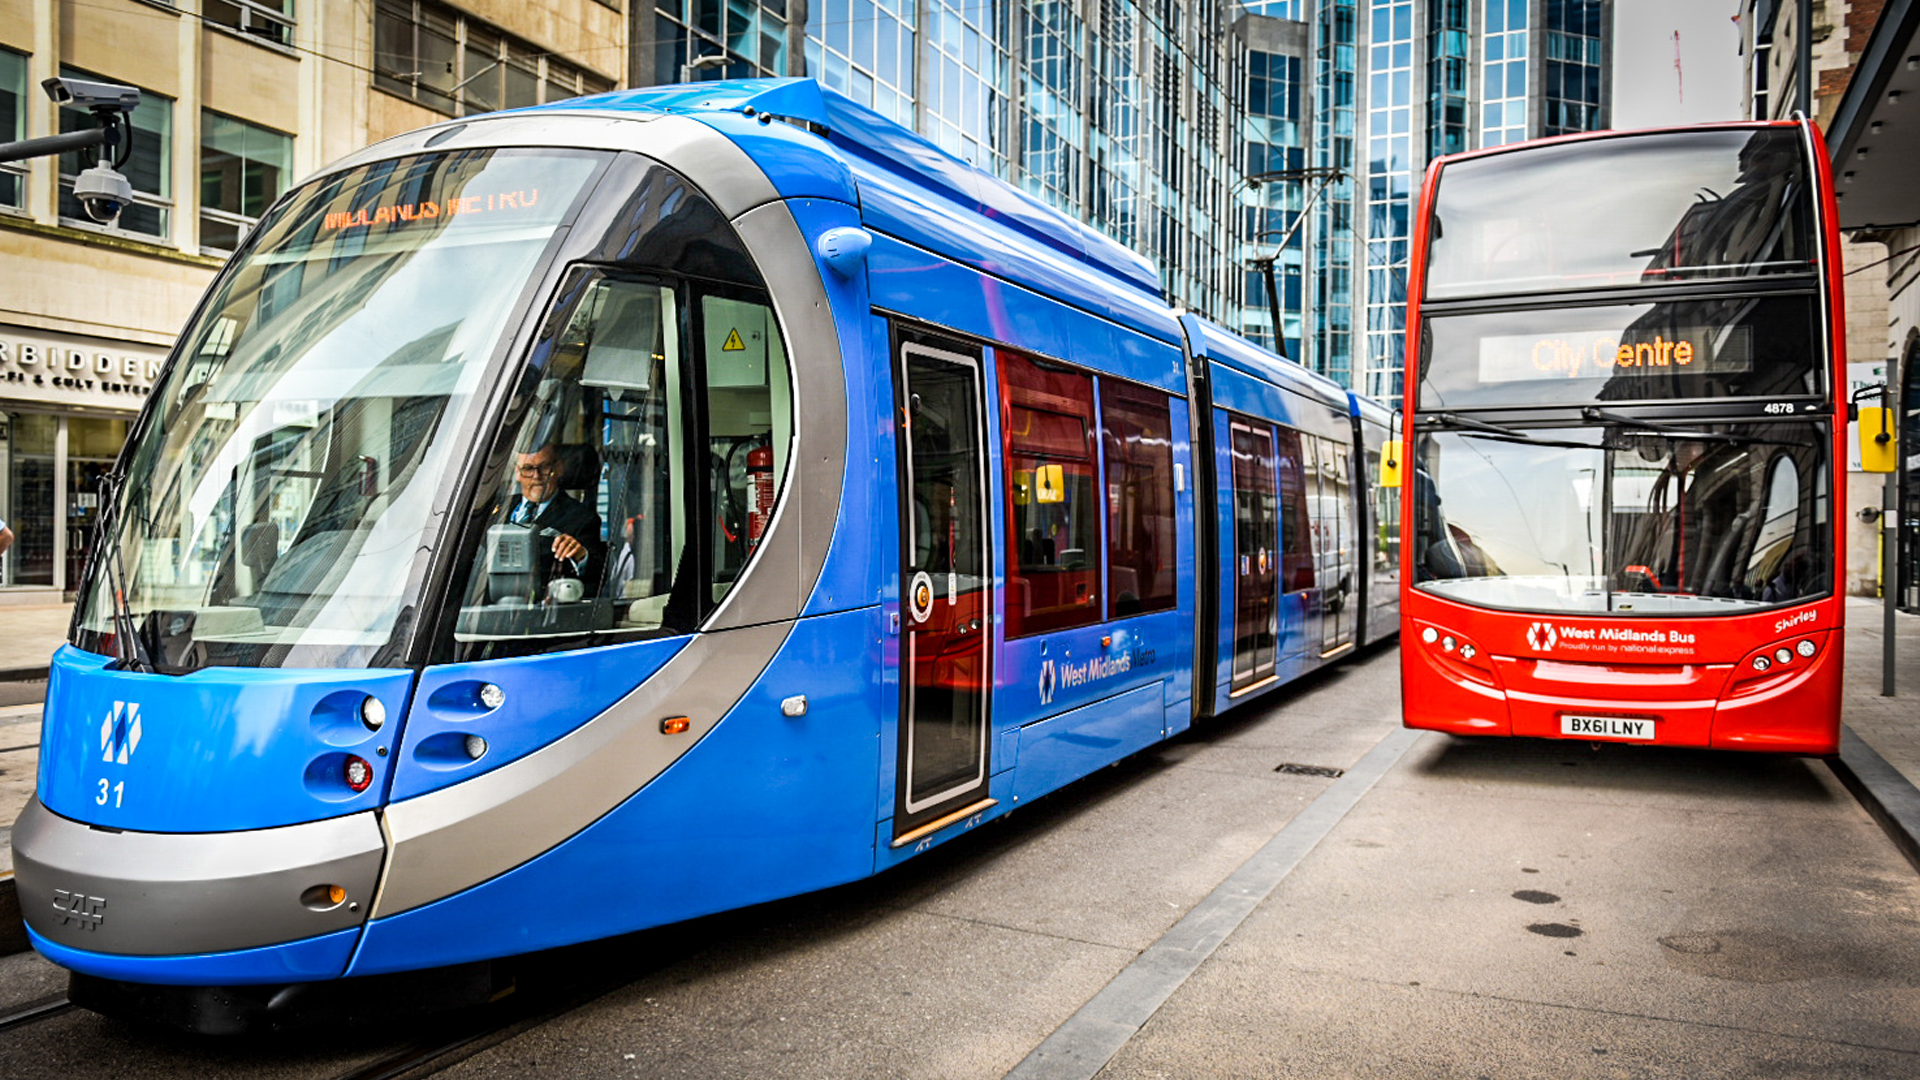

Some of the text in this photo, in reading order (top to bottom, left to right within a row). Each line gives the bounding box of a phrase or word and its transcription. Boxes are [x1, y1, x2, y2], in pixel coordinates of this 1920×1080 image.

[1532, 336, 1693, 378] City Centre
[52, 376, 94, 390] CULT
[1764, 403, 1794, 414] 4878
[1775, 609, 1817, 634] Shirley
[1559, 626, 1696, 644] West Midlands Bus
[1559, 641, 1590, 651] Proudly
[1592, 643, 1606, 651] run
[1608, 644, 1618, 653] by
[1061, 648, 1156, 690] West Midlands Metro
[1571, 718, 1644, 735] BX61 LNY
[96, 778, 124, 808] 31
[53, 888, 107, 932] CAF
